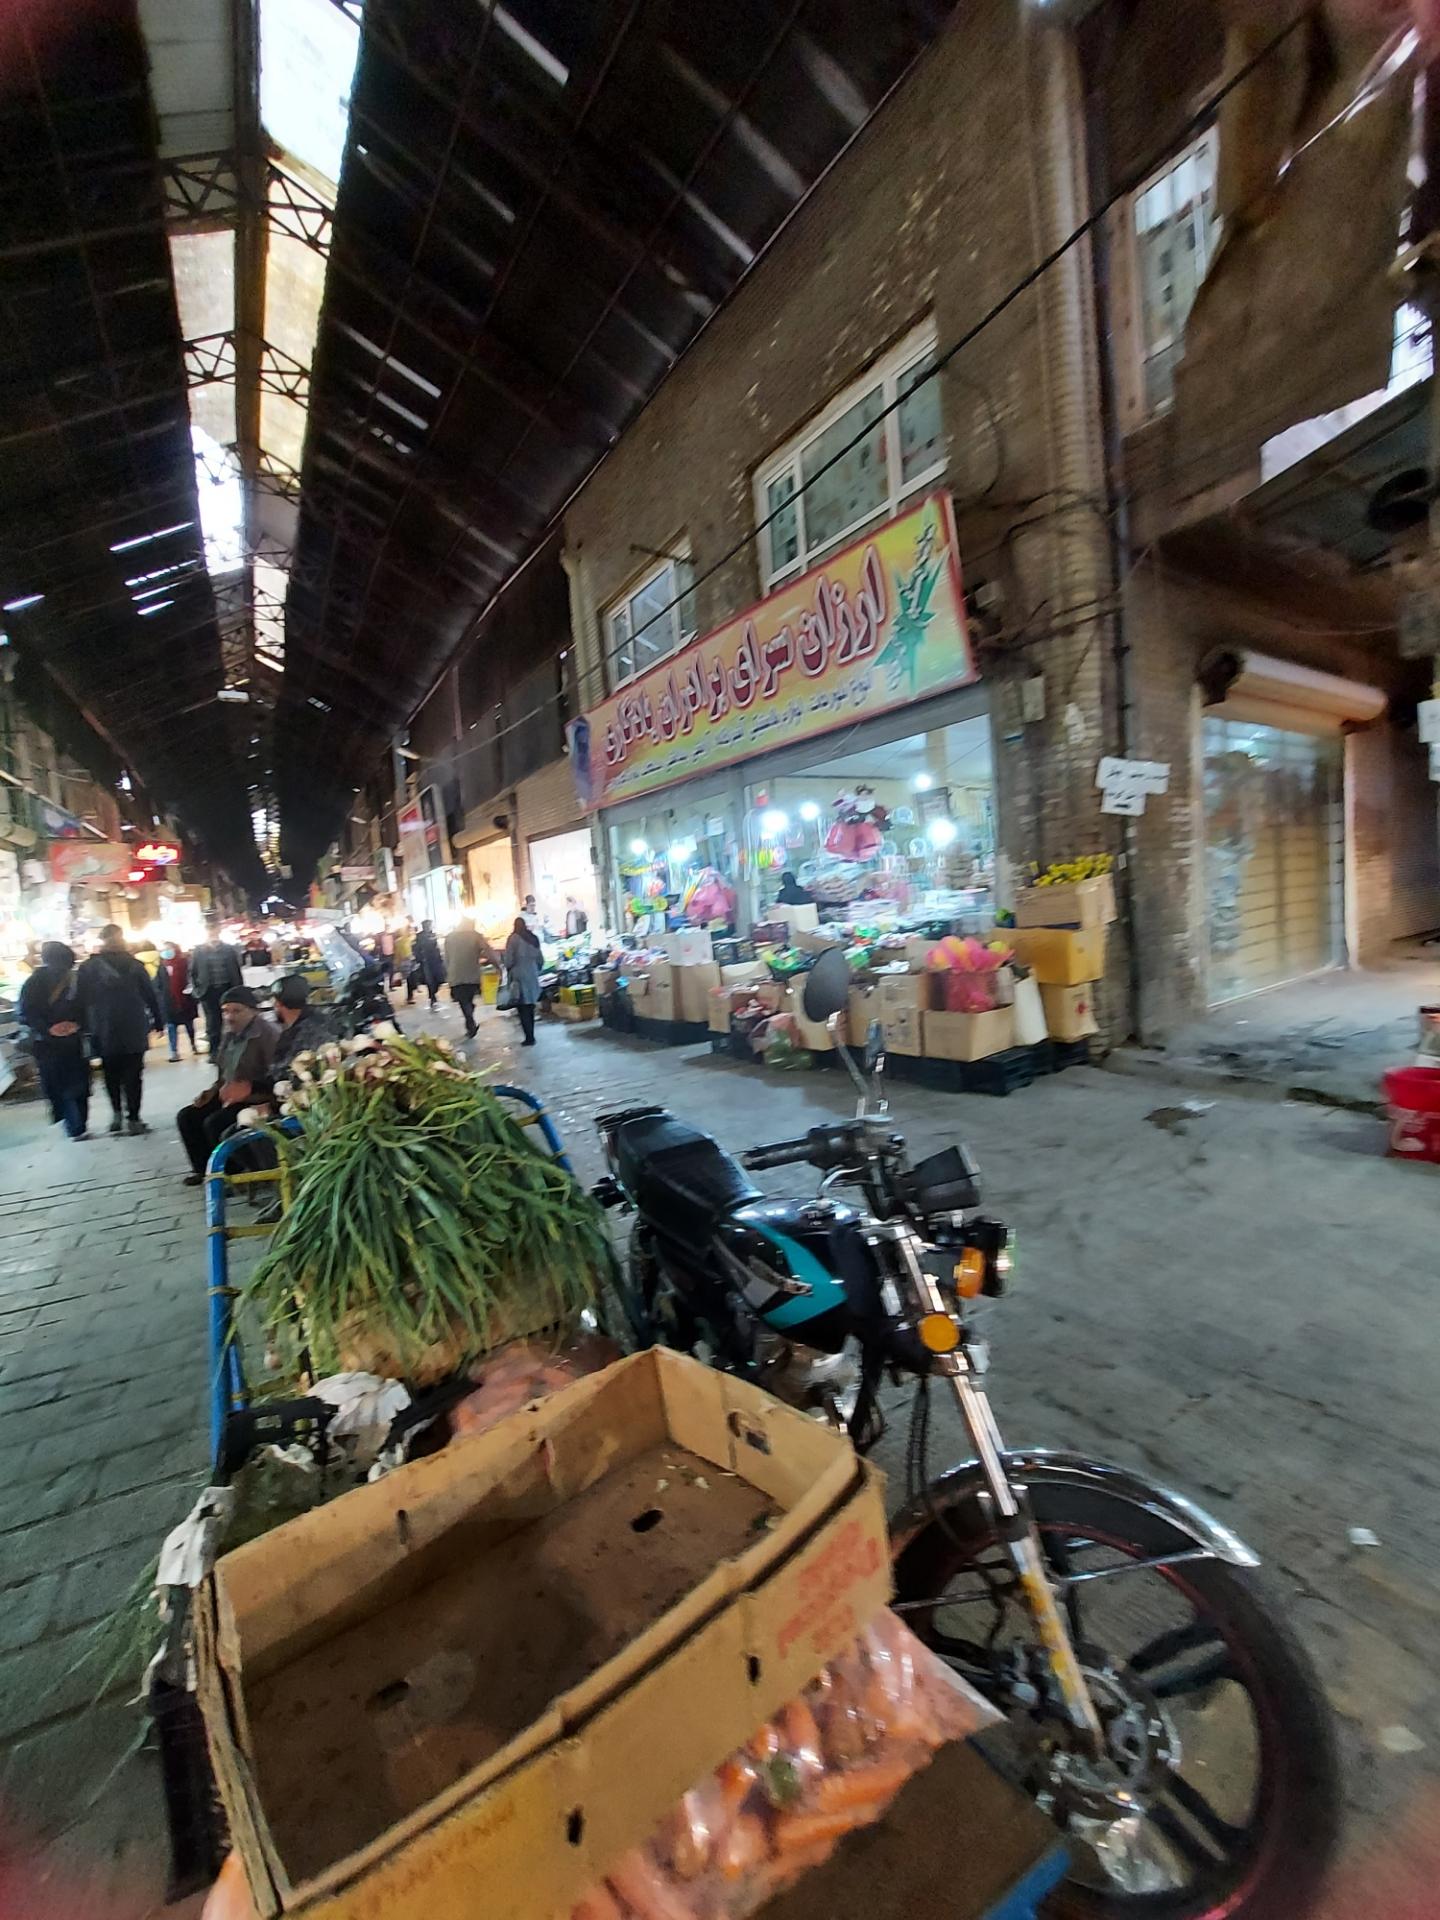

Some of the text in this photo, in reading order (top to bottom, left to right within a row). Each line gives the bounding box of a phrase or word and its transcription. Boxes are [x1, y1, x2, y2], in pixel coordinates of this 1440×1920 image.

[796, 543, 886, 677] ارزان
[656, 650, 729, 742] برادران
[728, 618, 795, 709] سرای
